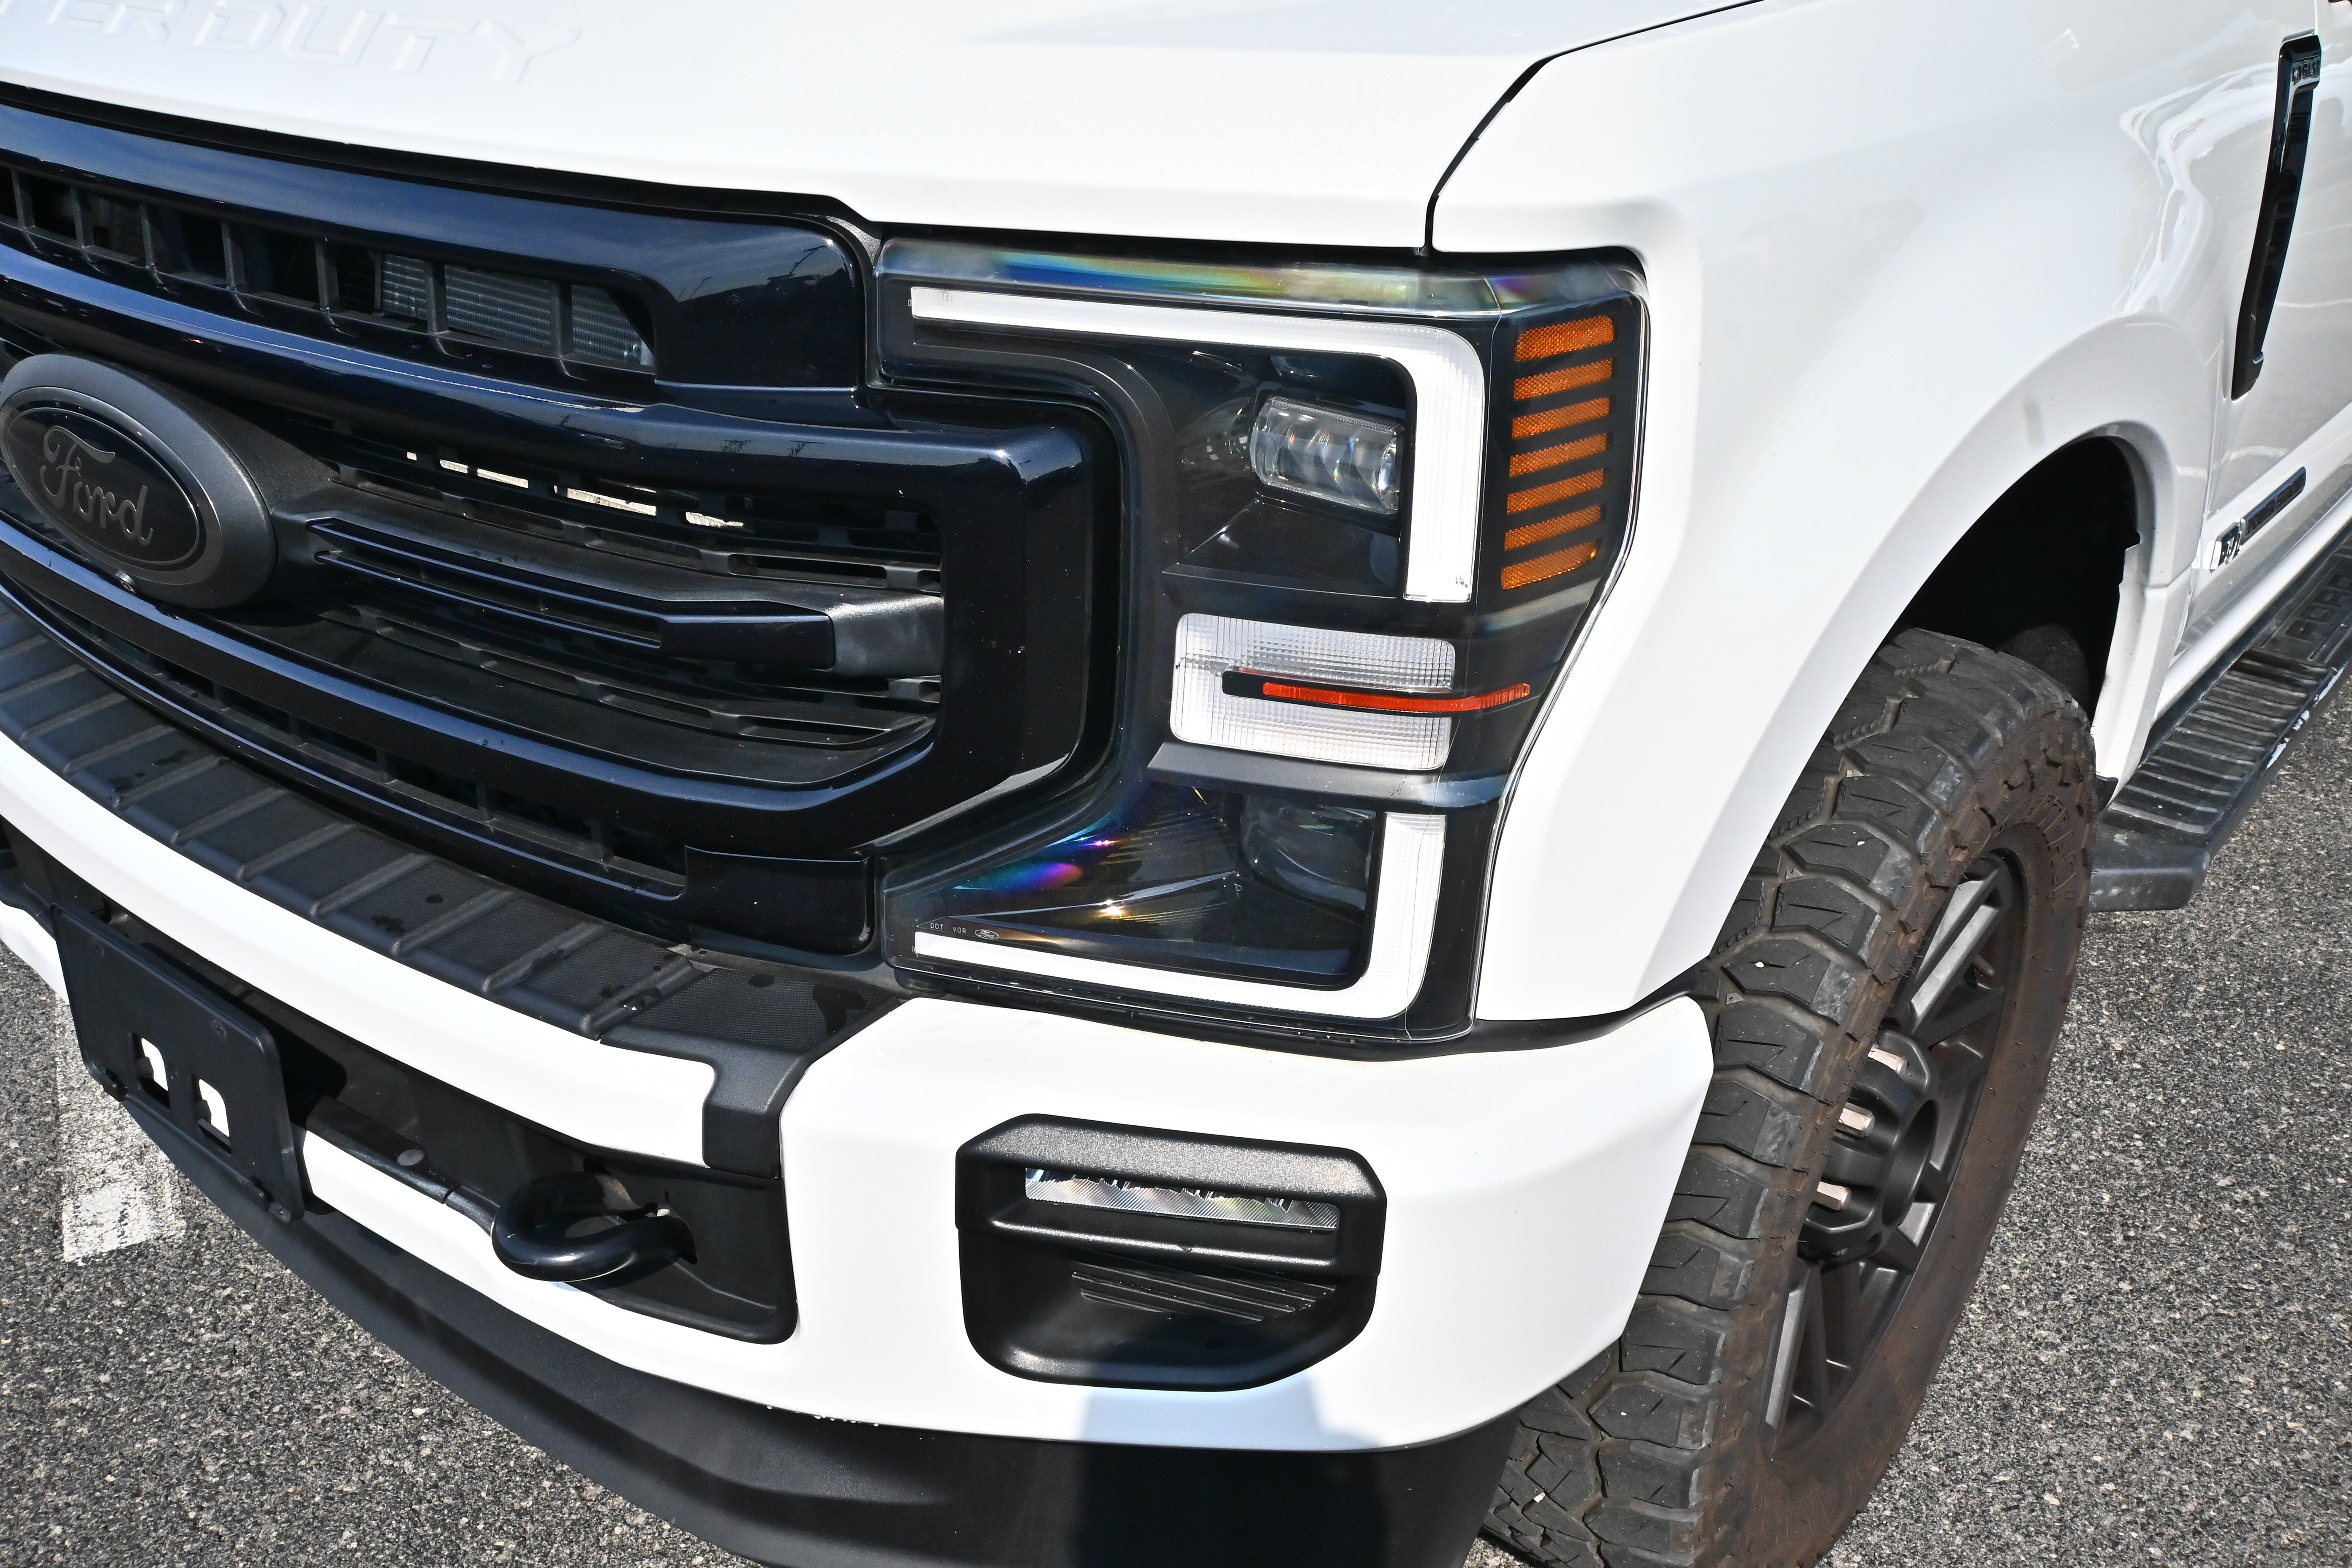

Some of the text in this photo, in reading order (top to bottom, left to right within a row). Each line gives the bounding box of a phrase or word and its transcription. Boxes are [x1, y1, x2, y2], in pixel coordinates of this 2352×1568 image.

[0, 0, 582, 84] ER DUTY
[40, 425, 153, 546] Ford
[930, 922, 944, 930] DOT
[953, 926, 966, 934] VOR
